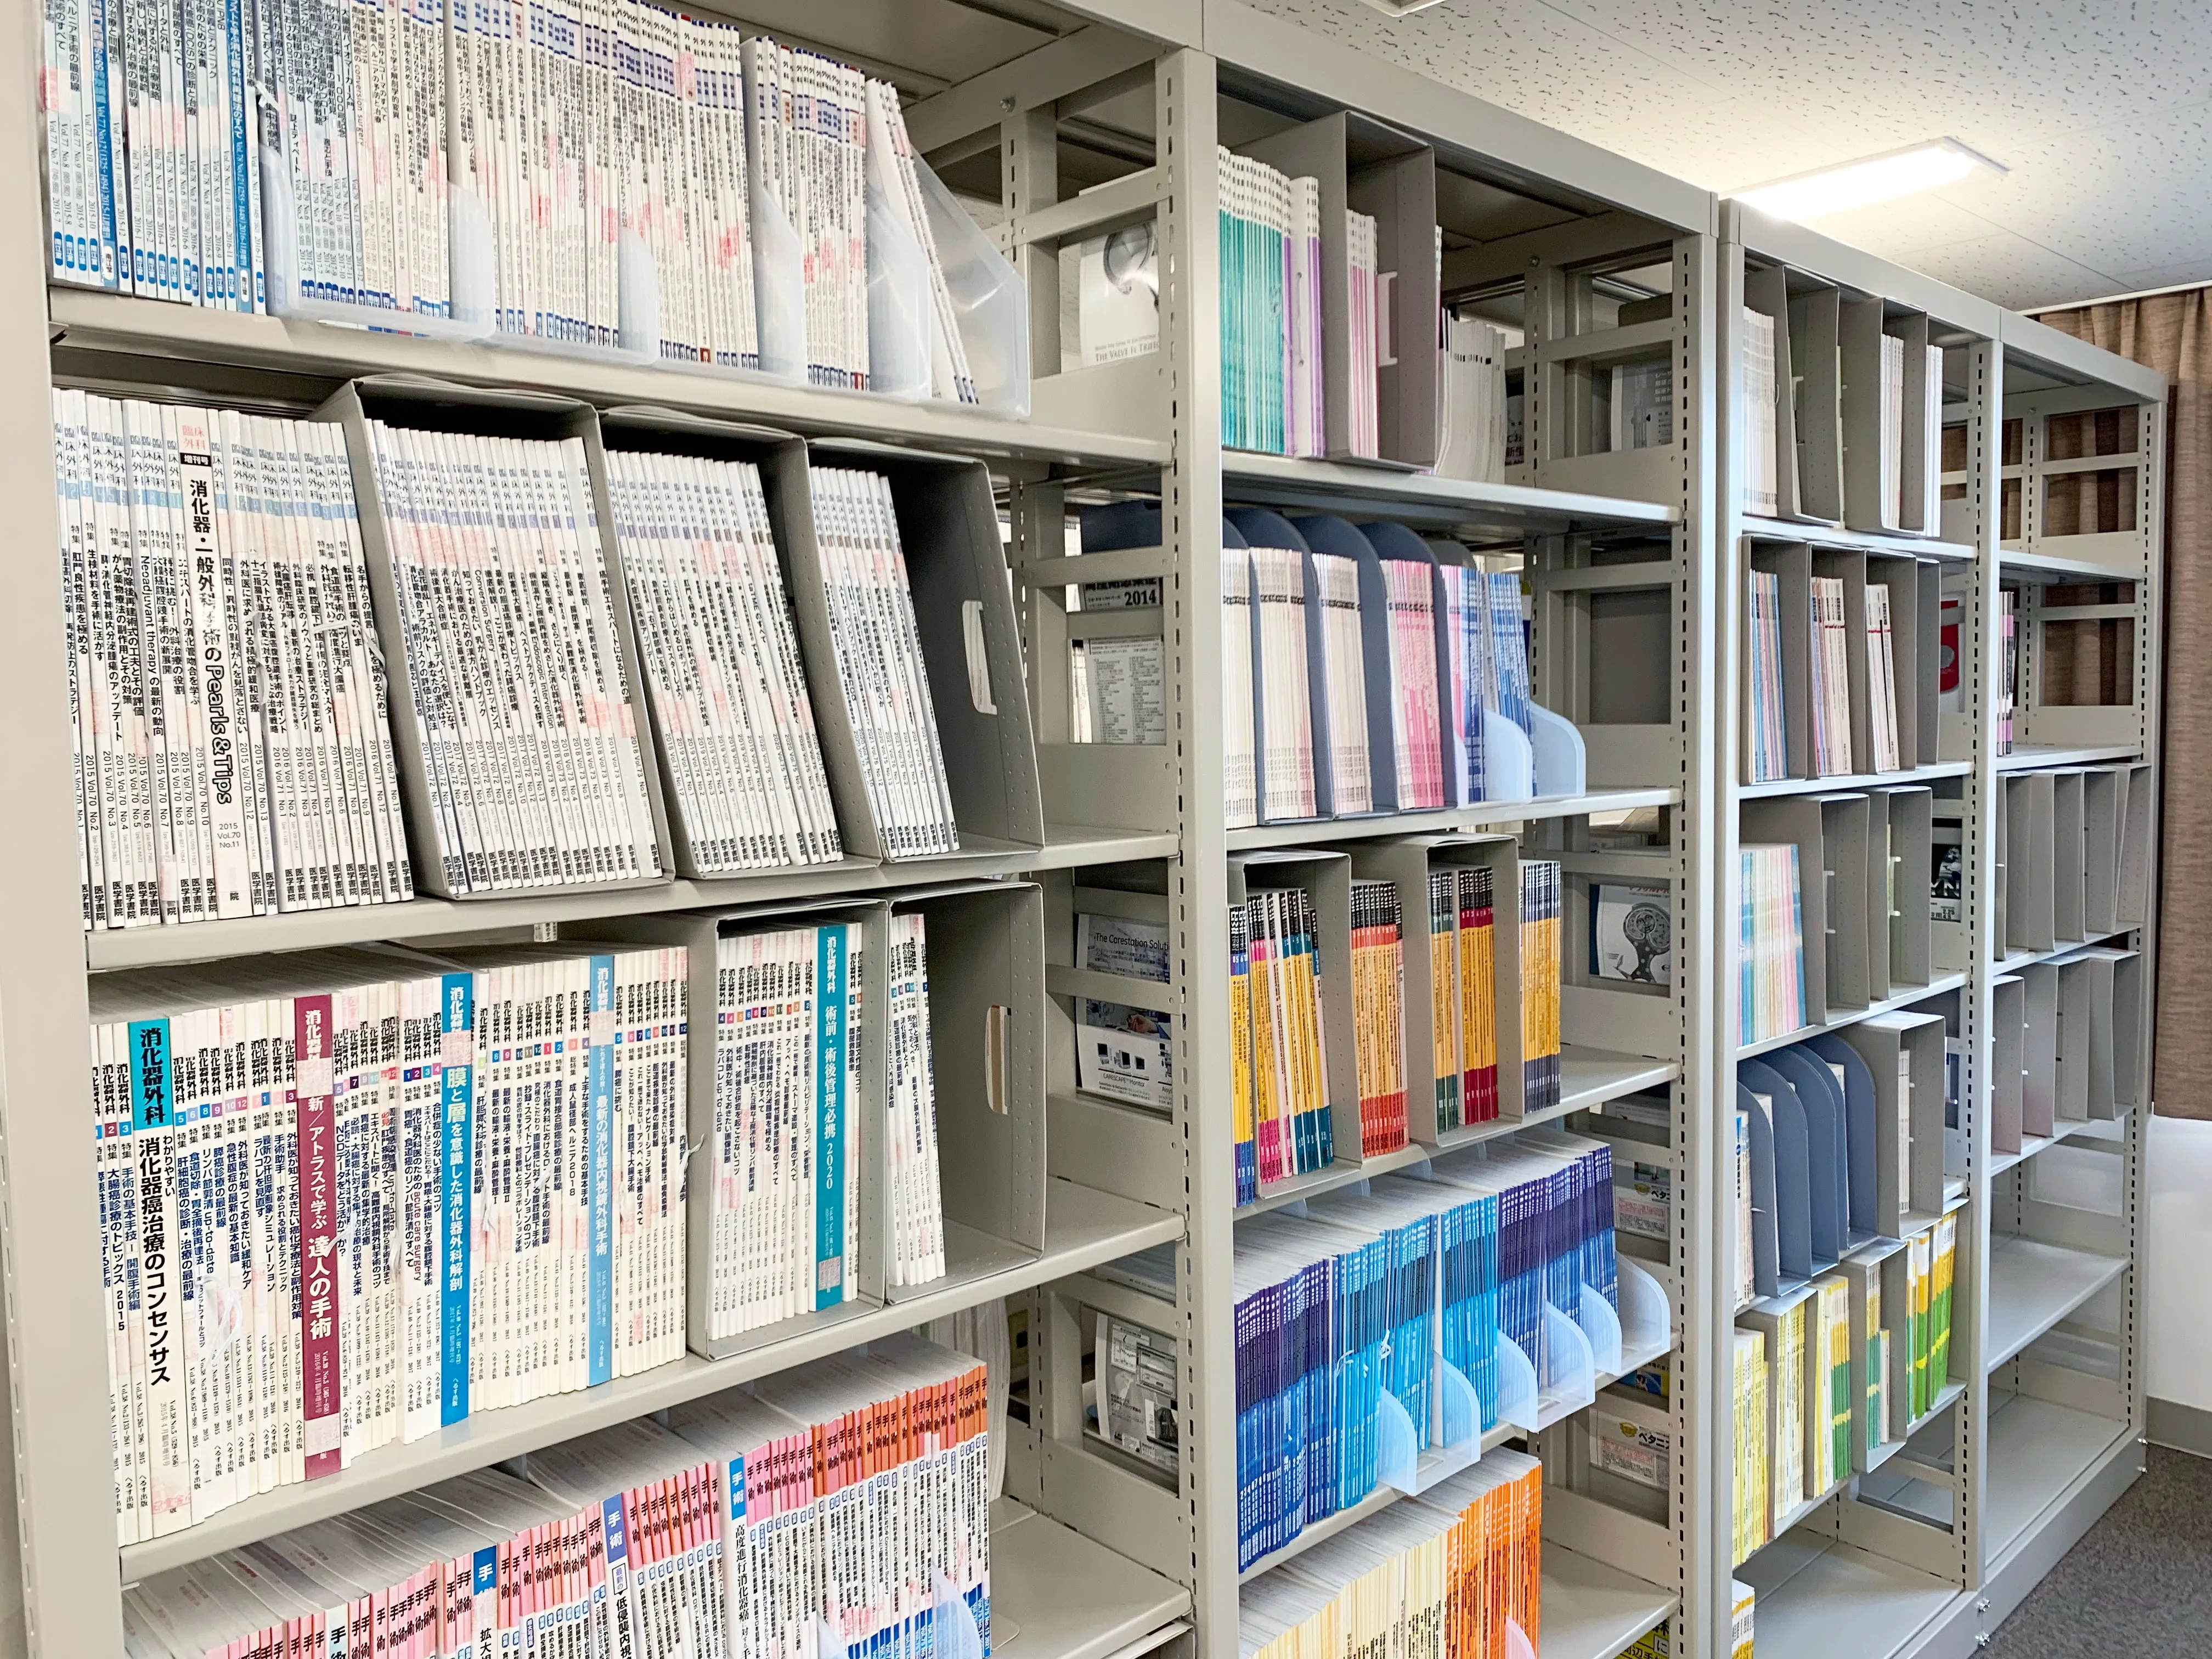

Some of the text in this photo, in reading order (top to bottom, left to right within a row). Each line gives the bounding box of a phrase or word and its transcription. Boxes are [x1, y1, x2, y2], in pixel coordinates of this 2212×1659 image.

[184, 455, 210, 466] 増刊号
[142, 556, 154, 629] Neoadjuvant
[1125, 590, 1156, 606] 2014
[146, 630, 157, 674] therapy
[150, 677, 163, 736] の最新の動向
[1094, 933, 1108, 943] The
[1109, 934, 1148, 947] Carestation
[826, 936, 837, 994] 消化器外科
[102, 1064, 115, 1115] 消化器外科
[117, 1063, 130, 1114] 消化器外科
[140, 1027, 165, 1125] 消化器外科
[199, 1048, 210, 1097] 消化器外科
[235, 1042, 246, 1090] 消化器外科
[824, 1005, 837, 1139] 術前・術後管理必携
[238, 1099, 246, 1108] 12
[238, 1116, 246, 1132] 特集
[287, 1109, 296, 1125] 特集
[106, 1143, 117, 1160] 特集
[121, 1143, 132, 1159] 特集
[177, 1132, 187, 1149] 特集
[432, 1102, 442, 1212] 合併症の少ない手術のコツ
[162, 1135, 175, 1197] わかりやすい
[213, 1147, 227, 1228] 膵癌診療の最前線
[446, 1068, 467, 1292] 膜と層を意識した消化器外科解剖
[122, 1167, 137, 1241] 手術の基本手技
[227, 1142, 240, 1263] 急性腹症の最新の基本知識
[238, 1141, 252, 1290] 外科医が知っておきたい緩和ケア
[274, 1135, 287, 1292] 手術助手 求められる役割とテクニック
[107, 1169, 124, 1285] 大腸癌診療のトピックス
[177, 1157, 194, 1301] 肝細胞癌の診断・治療の最前線
[127, 1257, 140, 1310] 開腹手術編
[138, 1137, 171, 1386] 消化器癌治療のコンセンサス
[116, 1290, 125, 1330] 2015
[308, 1235, 332, 1340] 達人の手術
[125, 1477, 134, 1510] へるす出版
[139, 1475, 148, 1507] へるす出版
[193, 1458, 202, 1490] へるす出版
[732, 1472, 744, 1505] 手術
[608, 1510, 623, 1549] 手術
[501, 1558, 510, 1600] 手術
[522, 1545, 532, 1586] 手術
[447, 1581, 455, 1624] 手術
[377, 1607, 385, 1651] 手術
